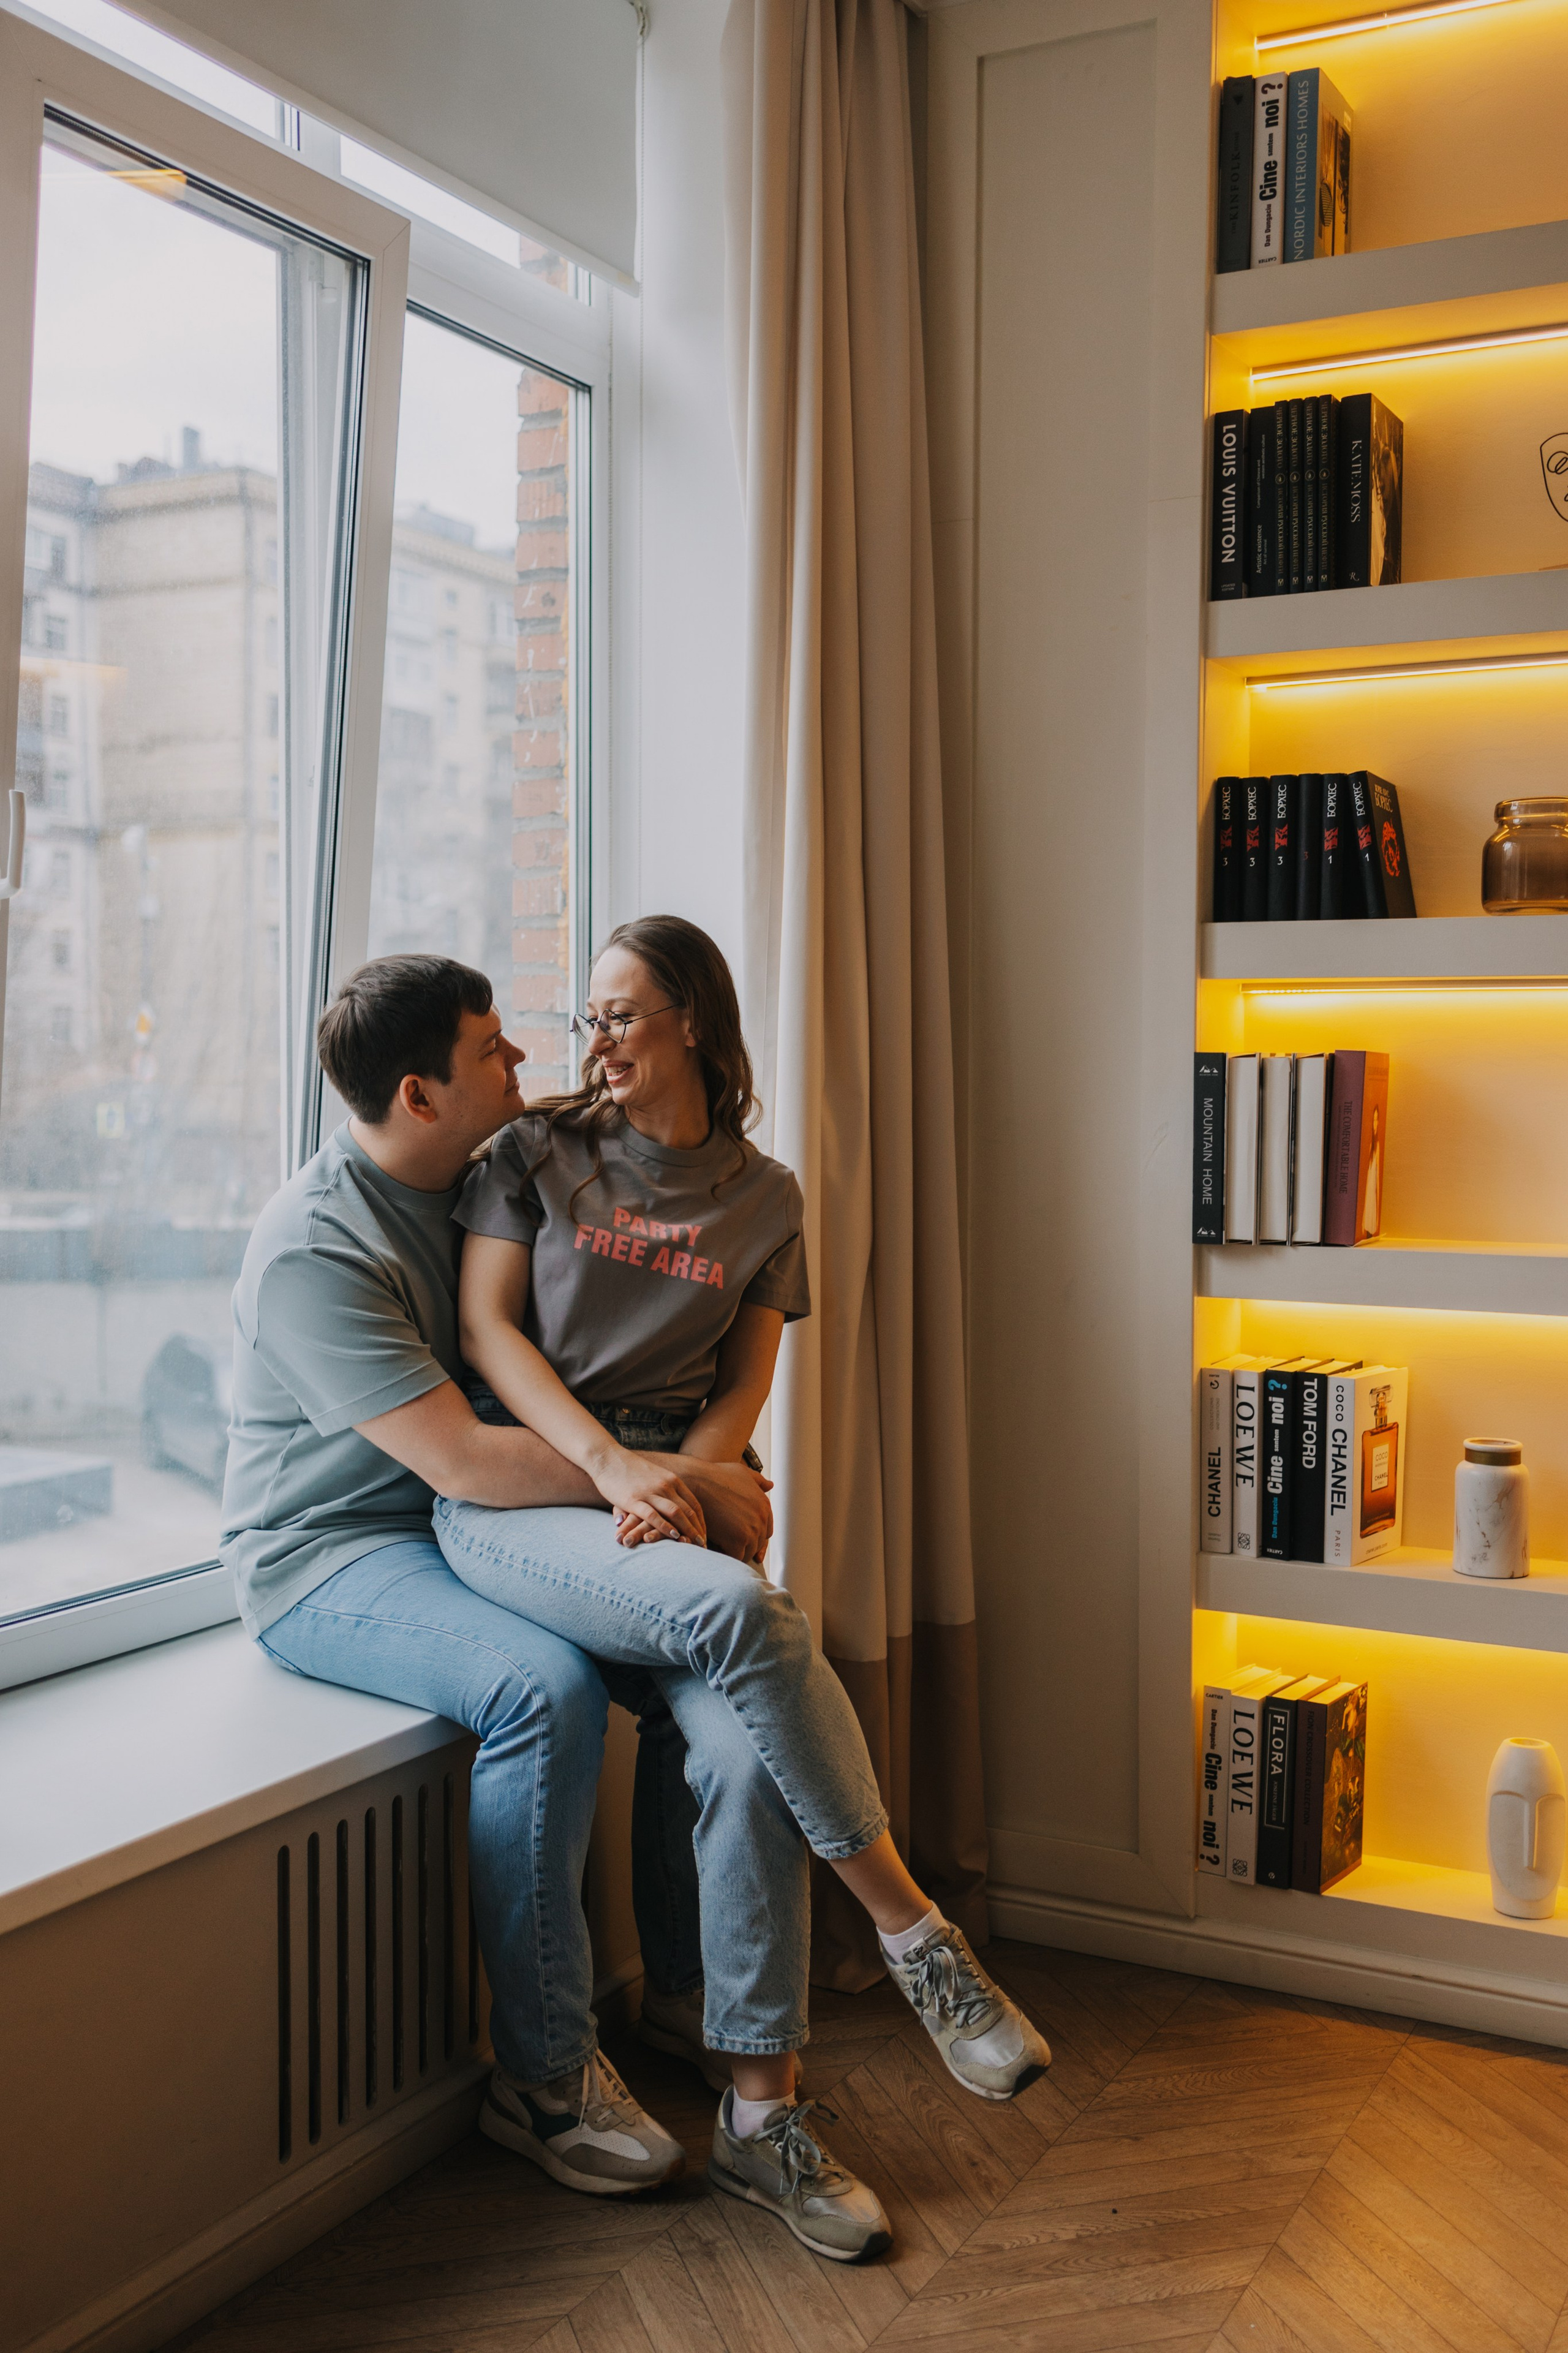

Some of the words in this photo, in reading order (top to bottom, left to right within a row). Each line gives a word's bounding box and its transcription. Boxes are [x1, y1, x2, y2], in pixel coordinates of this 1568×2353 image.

[1261, 82, 1284, 95] ?
[1297, 80, 1310, 130] HOMES
[1262, 99, 1280, 128] noi
[1229, 152, 1241, 221] KINFOLK
[1259, 160, 1278, 202] Cine
[1295, 133, 1308, 205] INTERIORS
[1293, 206, 1306, 260] NORDIC
[1222, 424, 1237, 477] LOUIS
[1352, 440, 1362, 480] KATE
[1351, 481, 1361, 523] MOSS
[1221, 483, 1236, 564] VUITTON
[1276, 519, 1285, 550] РУССКОЙ
[1222, 787, 1231, 820] БОРХЕС
[1248, 787, 1256, 820] БОРХЕС
[1277, 784, 1287, 818] БОРХЕС
[1327, 782, 1337, 817] БОРХЕС
[1353, 781, 1365, 817] БОРХЕС
[1223, 858, 1228, 866] 3
[1250, 858, 1255, 866] 3
[1277, 856, 1283, 865] 3
[1328, 855, 1332, 864] 1
[1364, 853, 1370, 861] 1
[1343, 1101, 1352, 1115] THE
[1203, 1098, 1213, 1161] MOUNTAIN
[1340, 1116, 1352, 1171] COMFORTABLE
[1202, 1169, 1212, 1205] HOME
[1339, 1172, 1349, 1194] HOME
[613, 1207, 702, 1247] PARTY
[574, 1223, 648, 1266] FREE
[650, 1246, 724, 1290] AREA
[1268, 1379, 1287, 1391] ?
[1303, 1378, 1317, 1417] TOM
[1336, 1384, 1344, 1422] COCO
[1268, 1396, 1284, 1424] noi
[1235, 1384, 1255, 1488] LOEWE
[1302, 1420, 1317, 1469] FORD
[1207, 1446, 1221, 1517] CHANEL
[1267, 1456, 1283, 1494] Cine
[1331, 1428, 1348, 1516] CHANEL
[1374, 1471, 1389, 1481] CHANEL
[1231, 1709, 1255, 1815] LOEWE
[1271, 1714, 1285, 1775] FLORA
[1305, 1731, 1314, 1777] CROSSOVER
[1204, 1753, 1223, 1791] Cine
[1303, 1778, 1312, 1826] COLLECTION
[1203, 1820, 1220, 1849] noi
[1199, 1853, 1220, 1866] ?
